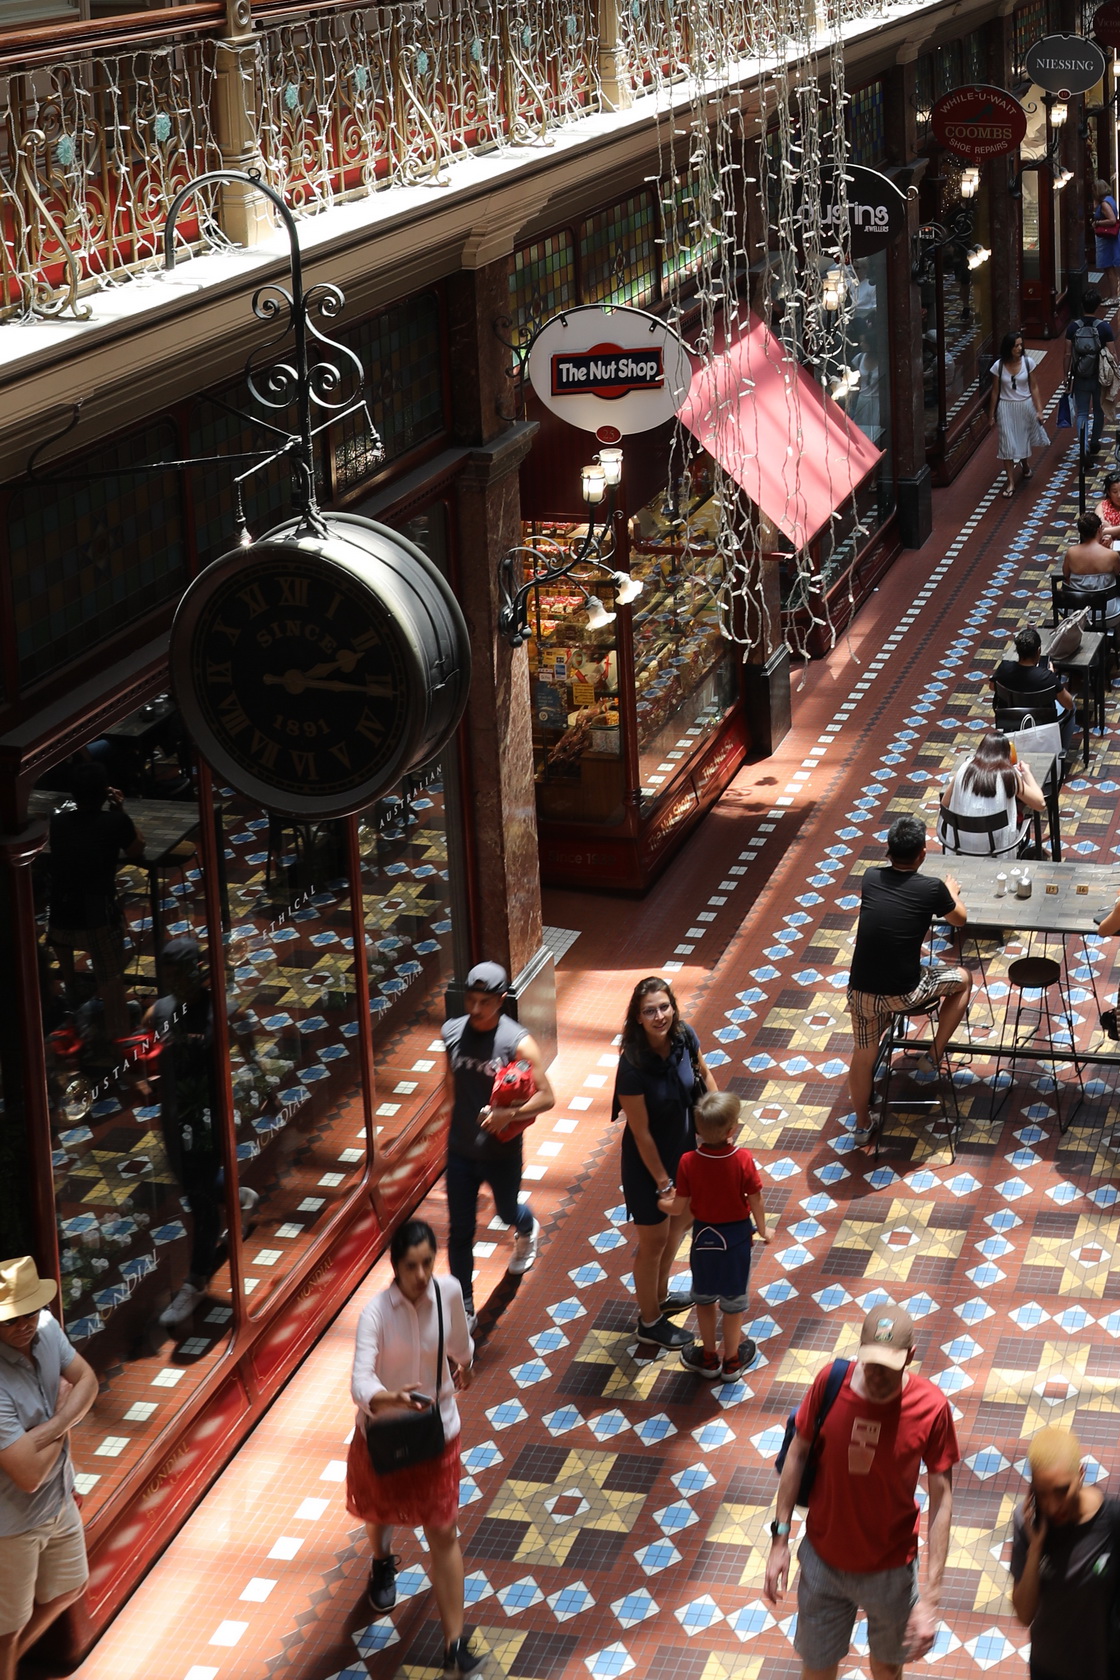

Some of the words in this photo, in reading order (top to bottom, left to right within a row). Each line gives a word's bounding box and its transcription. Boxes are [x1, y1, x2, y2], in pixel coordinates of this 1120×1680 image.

[1036, 58, 1095, 71] NIESSING
[940, 92, 1017, 115] WHILE-U-WAIT
[945, 126, 1012, 139] COOMBS
[949, 138, 971, 153] SHOE
[974, 140, 1008, 154] REPAIRS
[558, 362, 587, 383] The
[589, 360, 616, 380] Nut
[618, 358, 658, 381] Shop
[603, 430, 615, 439] 25
[256, 619, 338, 654] SINCE
[272, 714, 331, 738] 1891
[379, 764, 443, 829] AUSTRALIAN
[262, 885, 316, 941] ETHICAL
[81, 1002, 189, 1108] SUSTAINABLE
